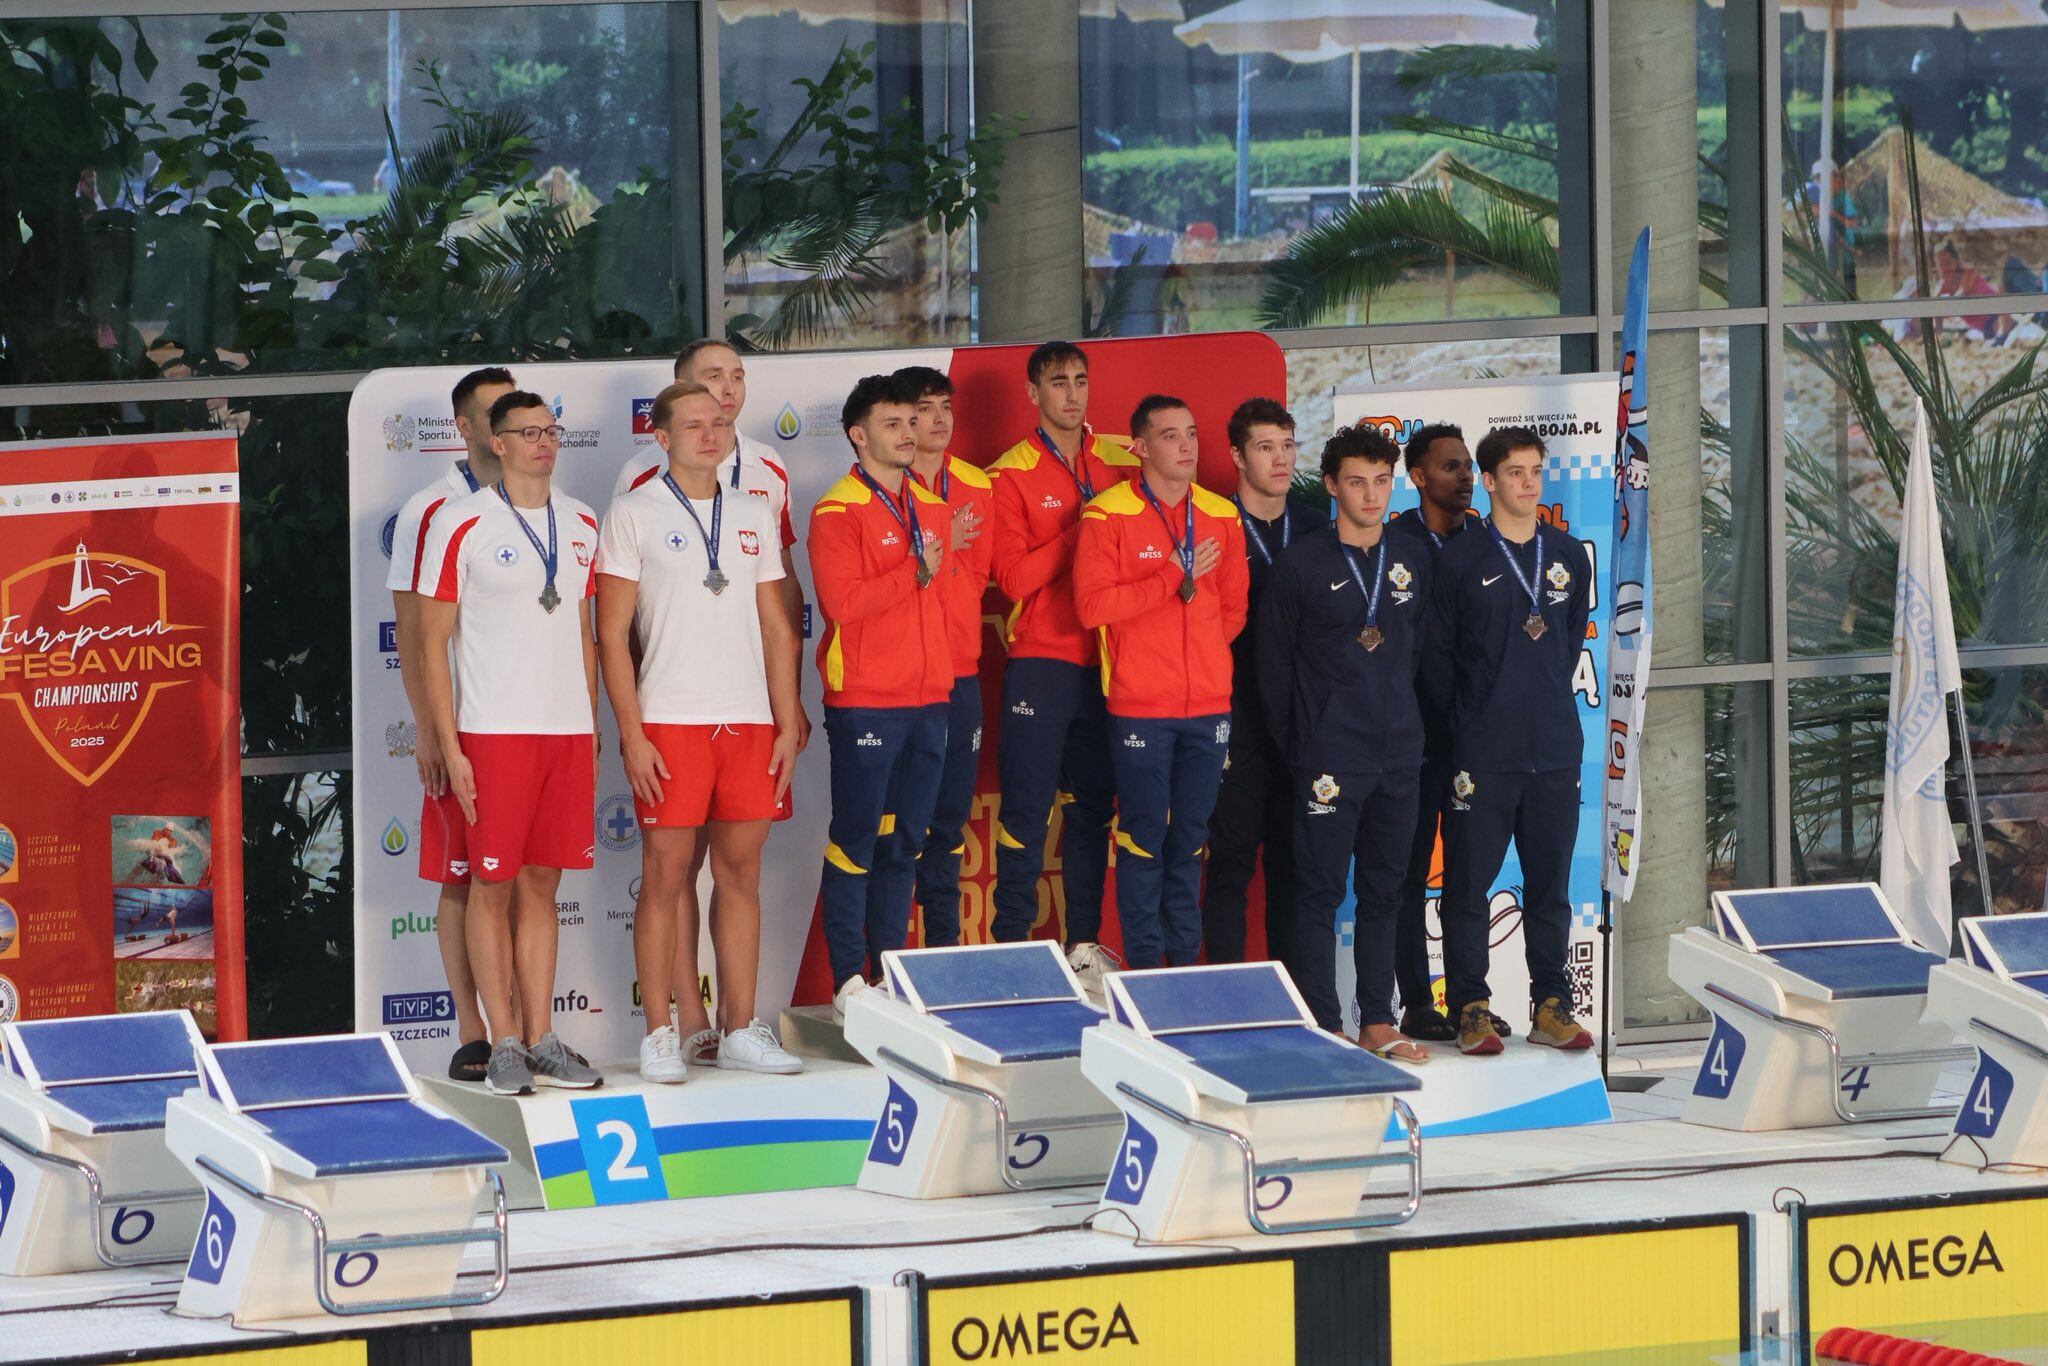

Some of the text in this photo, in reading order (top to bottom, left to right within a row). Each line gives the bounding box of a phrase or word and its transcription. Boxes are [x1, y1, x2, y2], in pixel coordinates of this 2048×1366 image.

[418, 431, 452, 443] Sportu
[1488, 414, 1522, 424] DOWIEDŹ
[1524, 414, 1535, 424] SIĘ
[1537, 413, 1565, 423] WIĘCEJ
[0, 614, 174, 661] European
[34, 681, 140, 709] CHAMPIONSHIPS
[54, 712, 121, 738] Poland
[70, 736, 105, 748] 2025
[27, 835, 59, 846] SZCZECIN
[392, 995, 451, 1017] TVP 3
[389, 1027, 451, 1042] SZCZECIN
[1710, 1038, 1729, 1088] 4
[1973, 1075, 1995, 1126] 4
[596, 1119, 649, 1181] 2
[887, 1102, 905, 1155] 5
[1124, 1139, 1145, 1191] 5
[206, 1213, 224, 1270] 6
[1828, 1230, 2005, 1288] OMEGA
[951, 1301, 1140, 1362] OMEGA
